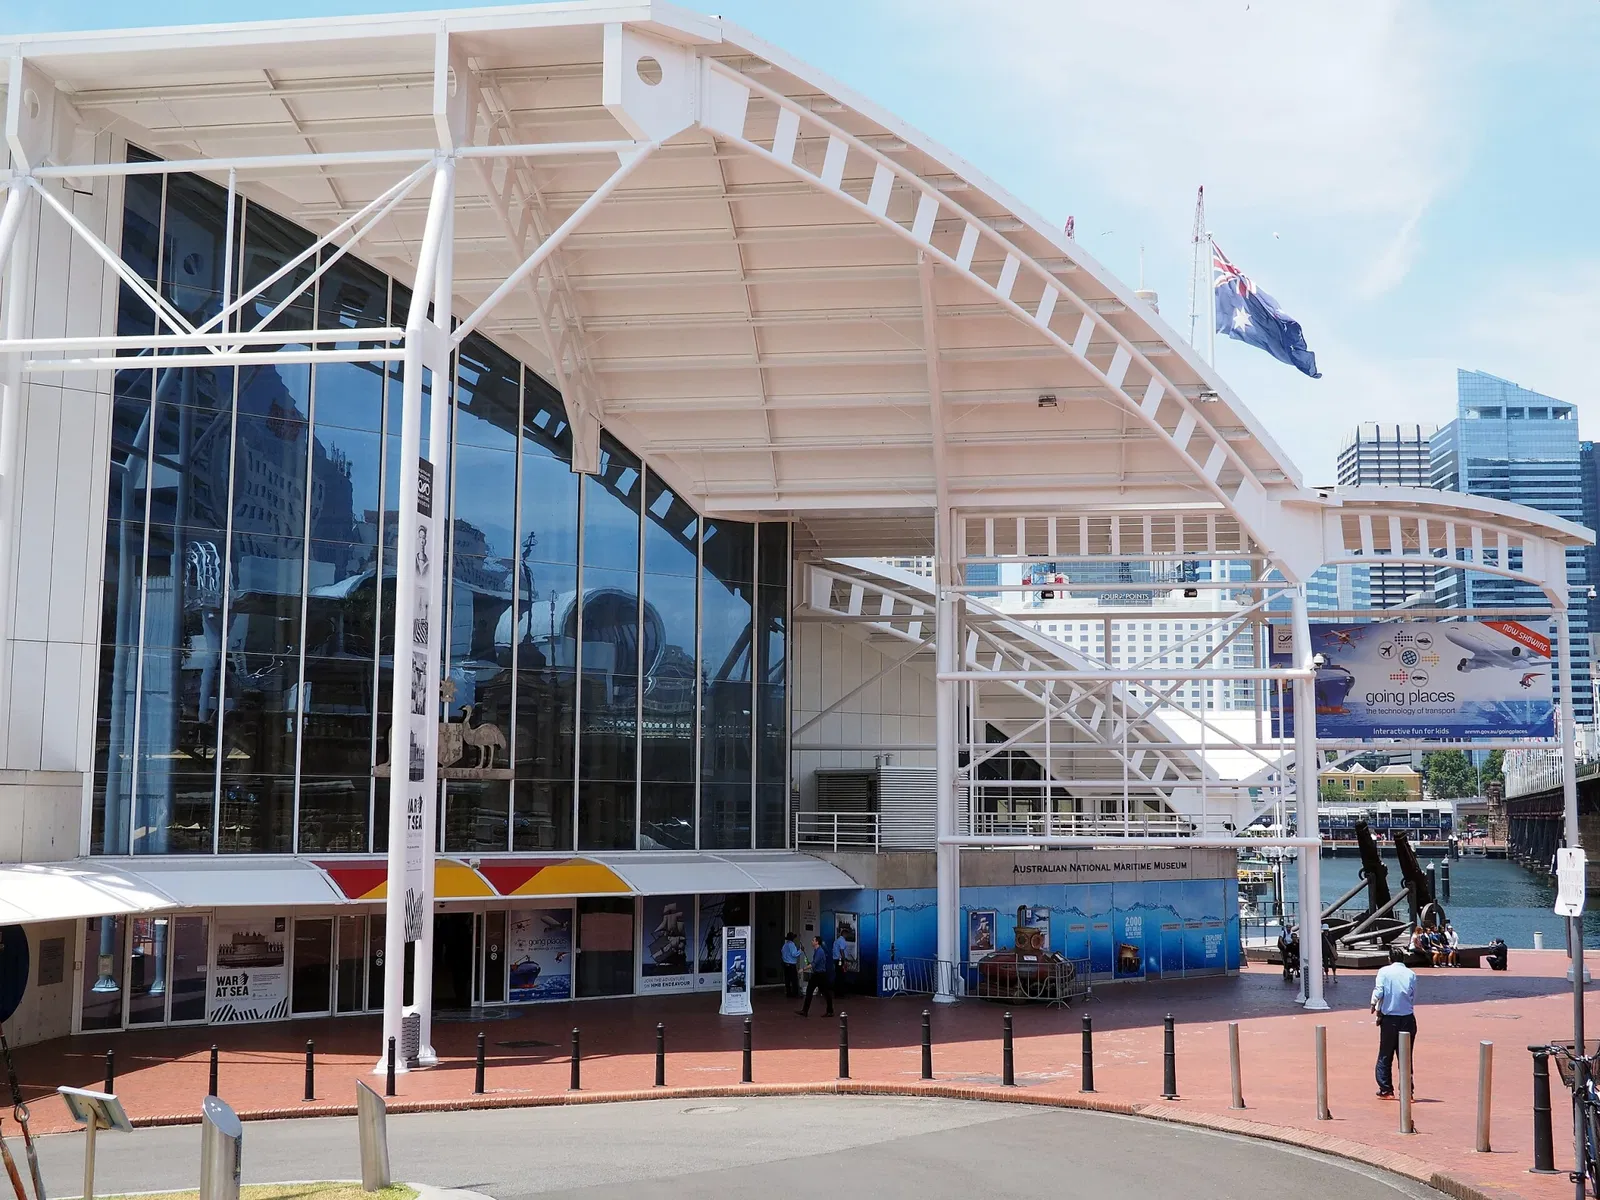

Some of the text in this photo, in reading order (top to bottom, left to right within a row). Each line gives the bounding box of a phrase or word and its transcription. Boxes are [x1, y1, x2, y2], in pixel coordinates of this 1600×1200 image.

[1502, 623, 1548, 652] NOW SHOWING
[1365, 689, 1455, 706] going places
[1378, 708, 1416, 716] technology
[1373, 727, 1450, 735] Interactive fun for kids
[412, 815, 422, 830] SEA
[1013, 861, 1187, 873] AUSTRALIAN NATIONAL MARITIME MUSEUM
[528, 938, 545, 947] going
[216, 976, 239, 987] WAR
[883, 976, 905, 991] LOOK
[215, 986, 249, 998] AT SEA
